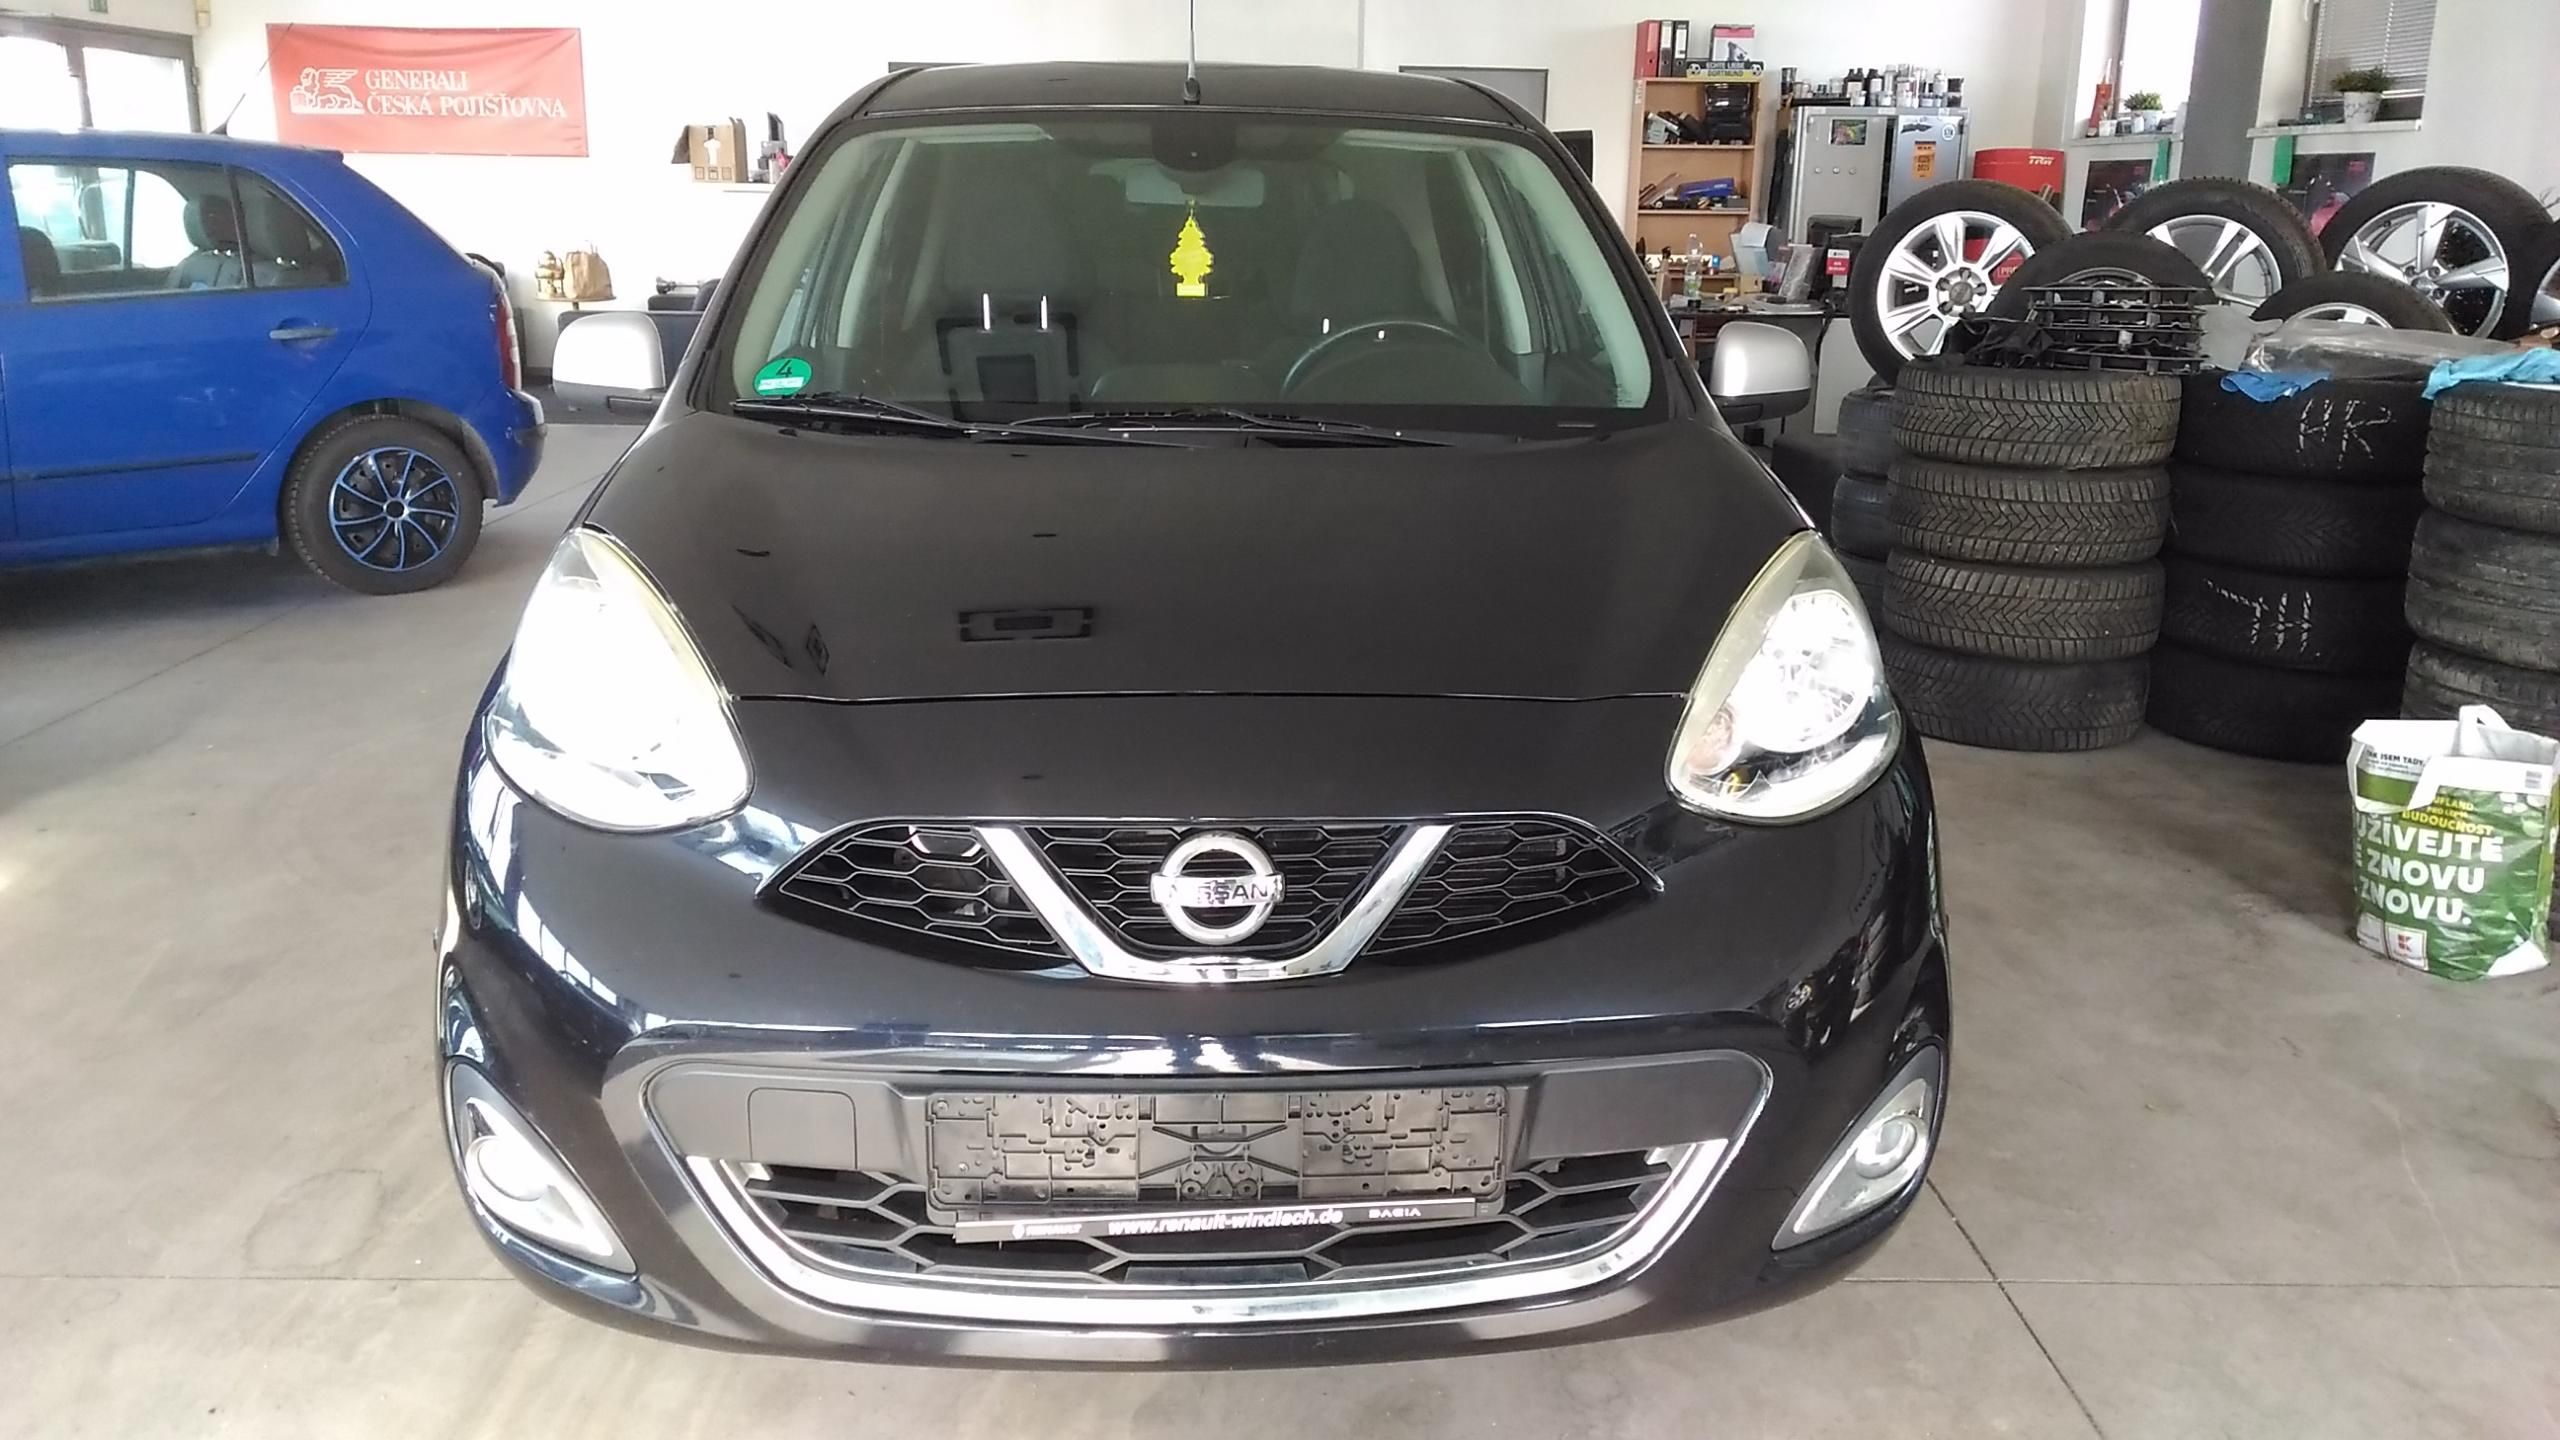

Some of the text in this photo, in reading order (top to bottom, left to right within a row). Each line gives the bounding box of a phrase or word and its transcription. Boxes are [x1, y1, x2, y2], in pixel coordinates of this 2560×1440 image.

[364, 69, 469, 92] GENERALI
[366, 91, 568, 119] ČESKÁ POJIŠŤOVNA
[2028, 155, 2055, 166] TRW
[775, 359, 793, 379] 4
[2355, 811, 2505, 863] UŽÍVEJTE
[2366, 848, 2486, 894] ZNOVU
